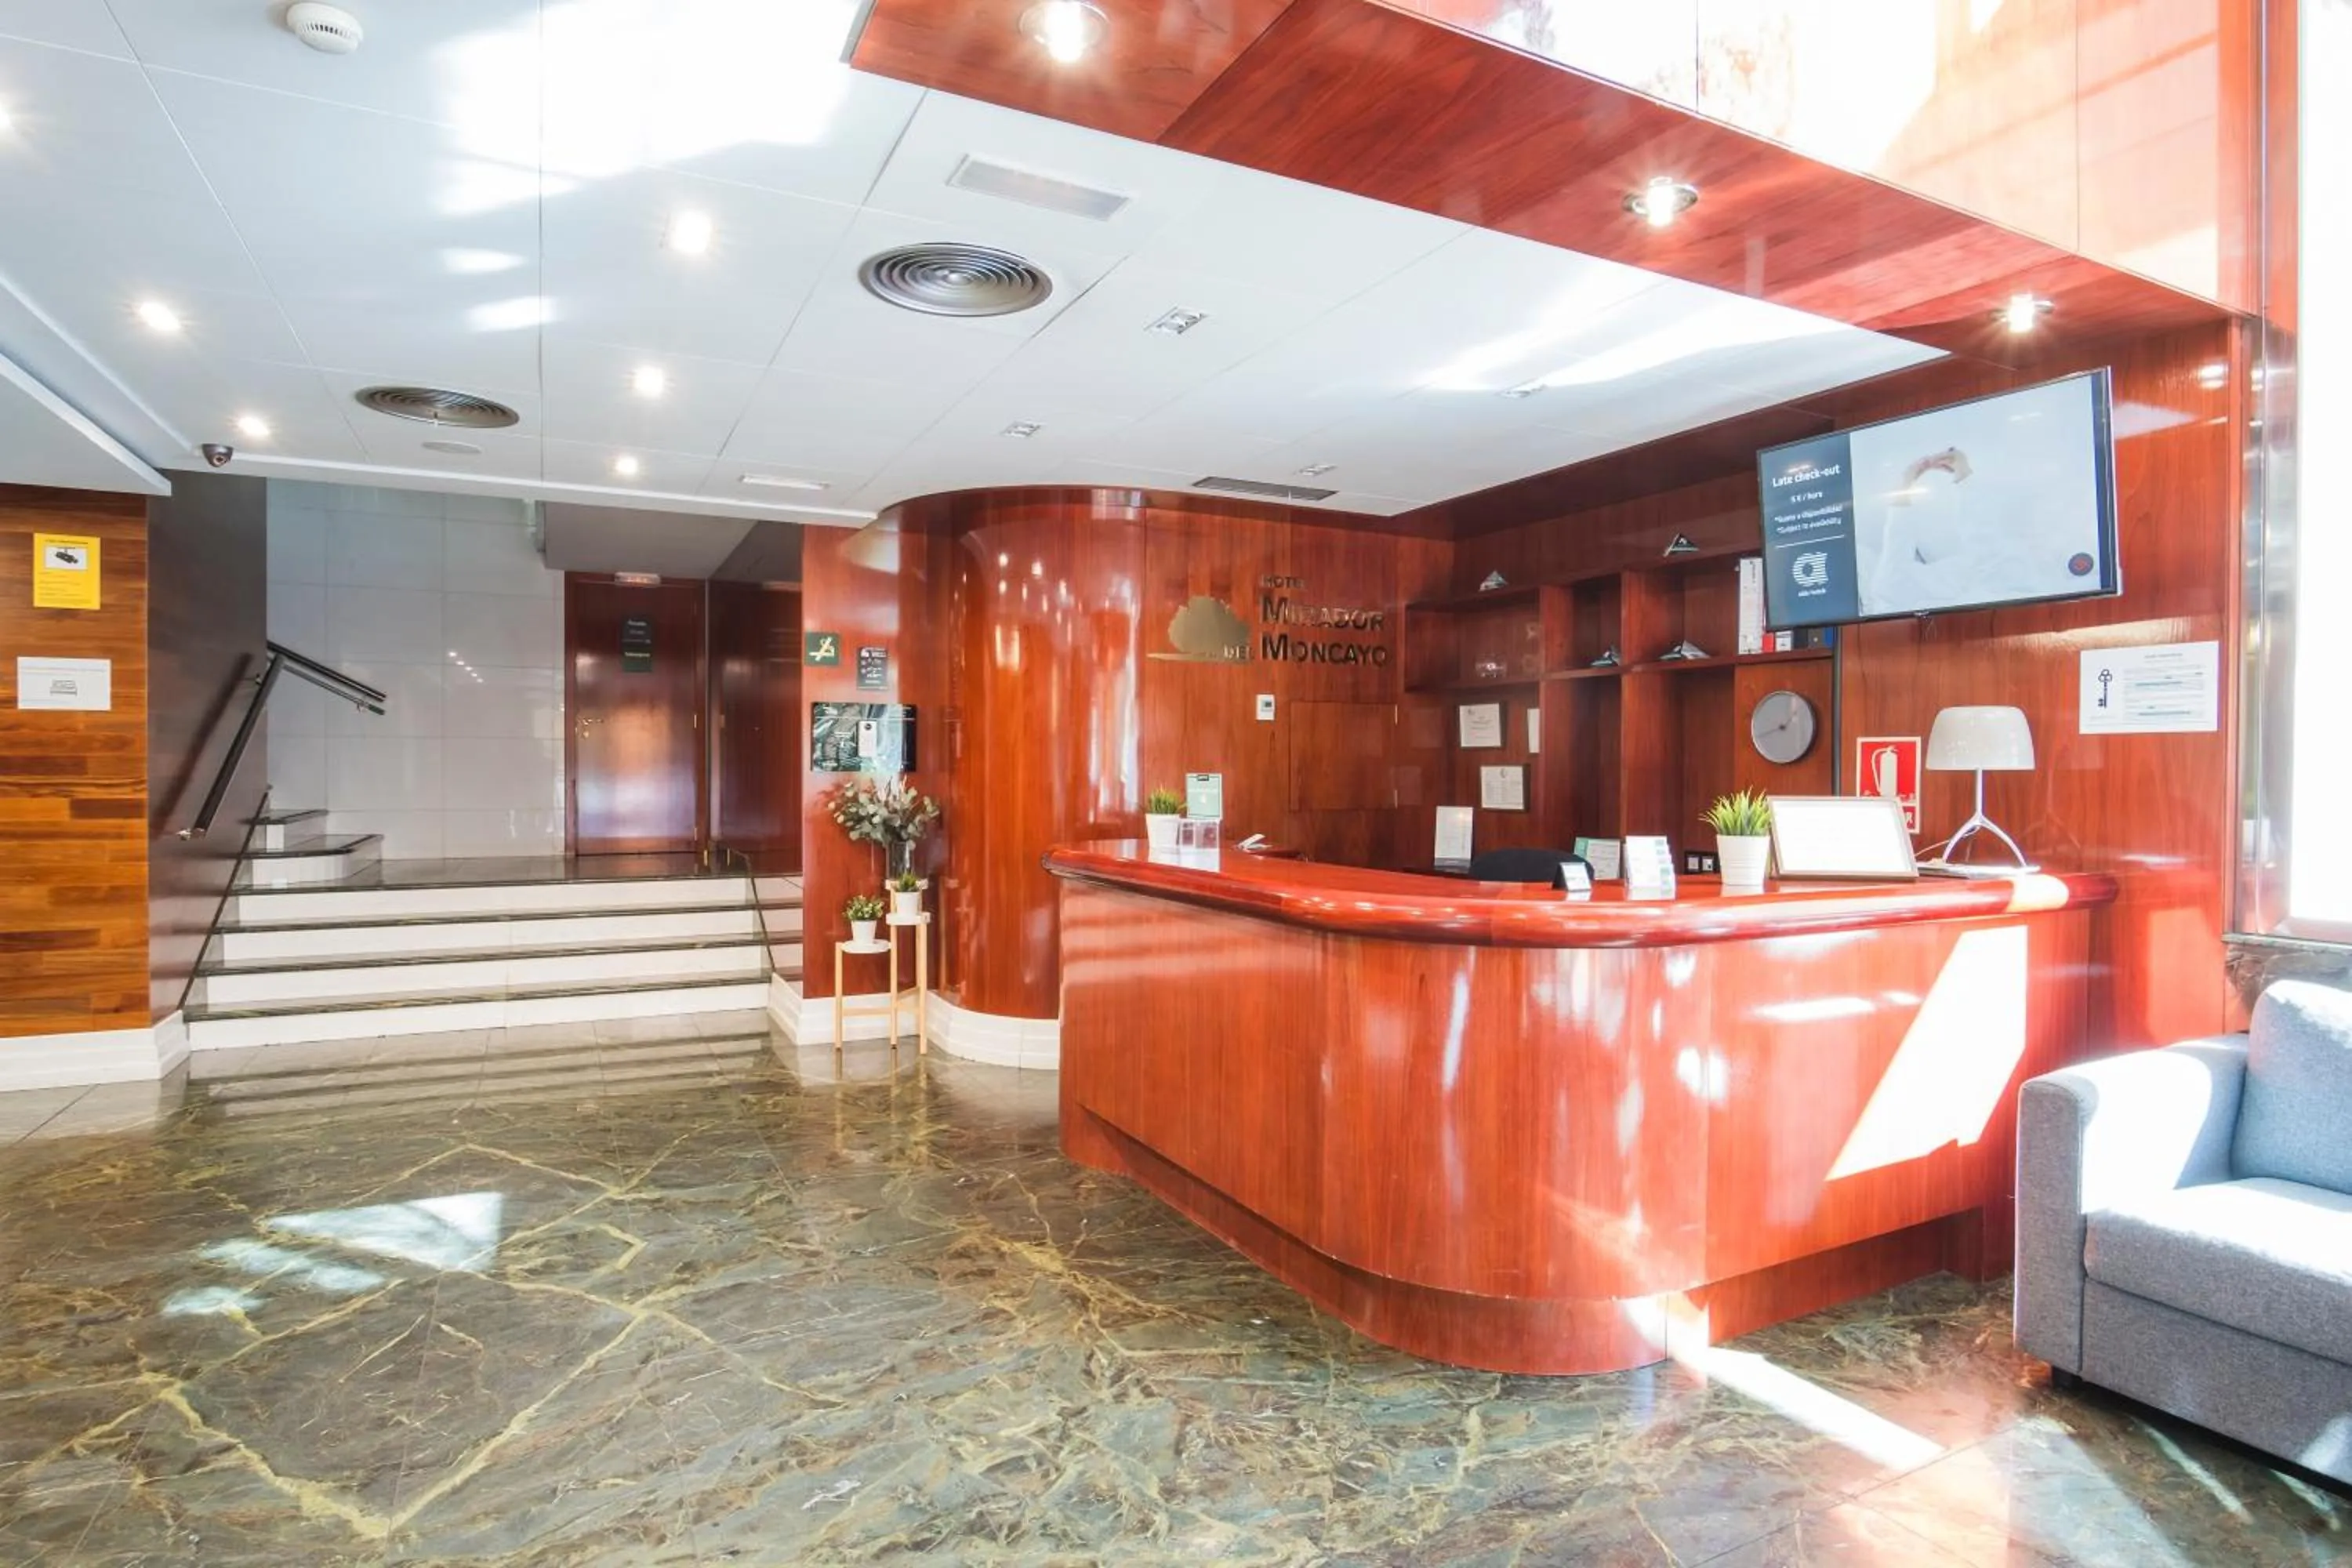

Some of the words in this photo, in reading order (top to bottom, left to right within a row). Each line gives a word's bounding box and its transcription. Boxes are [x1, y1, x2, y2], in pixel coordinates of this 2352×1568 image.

[1772, 477, 1793, 488] Late
[1795, 463, 1840, 483] check-out
[1260, 632, 1388, 667] MONCAYO
